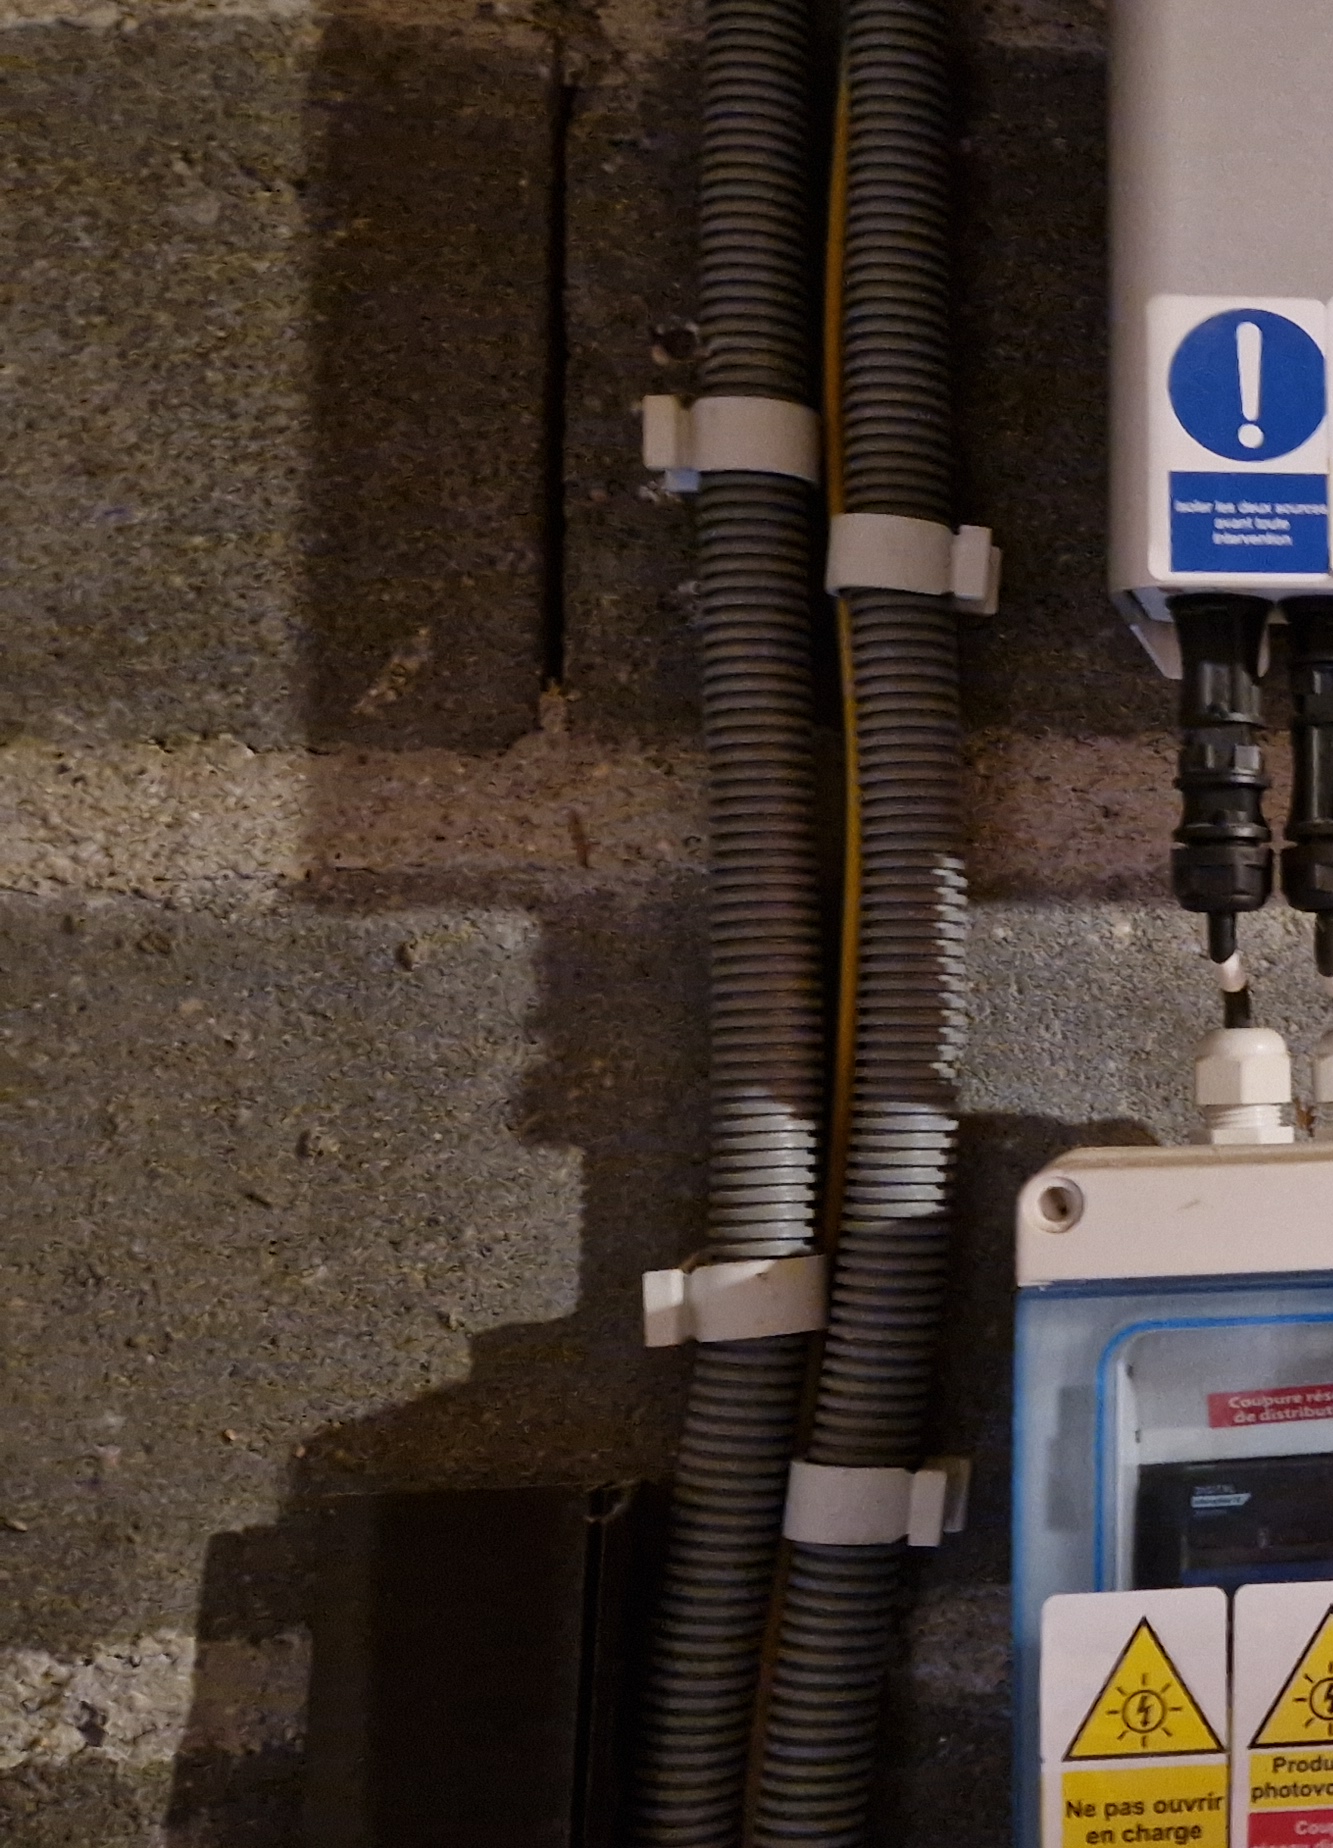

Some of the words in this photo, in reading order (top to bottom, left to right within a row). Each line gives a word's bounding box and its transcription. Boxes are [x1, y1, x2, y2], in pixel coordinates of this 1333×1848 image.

[1228, 1392, 1304, 1410] Coupure
[1232, 1410, 1257, 1424] de
[1066, 1800, 1097, 1819] Ne
[1103, 1797, 1145, 1821] pas
[1153, 1791, 1224, 1814] ouvrir
[1085, 1828, 1115, 1845] en
[1121, 1822, 1203, 1847] charge
